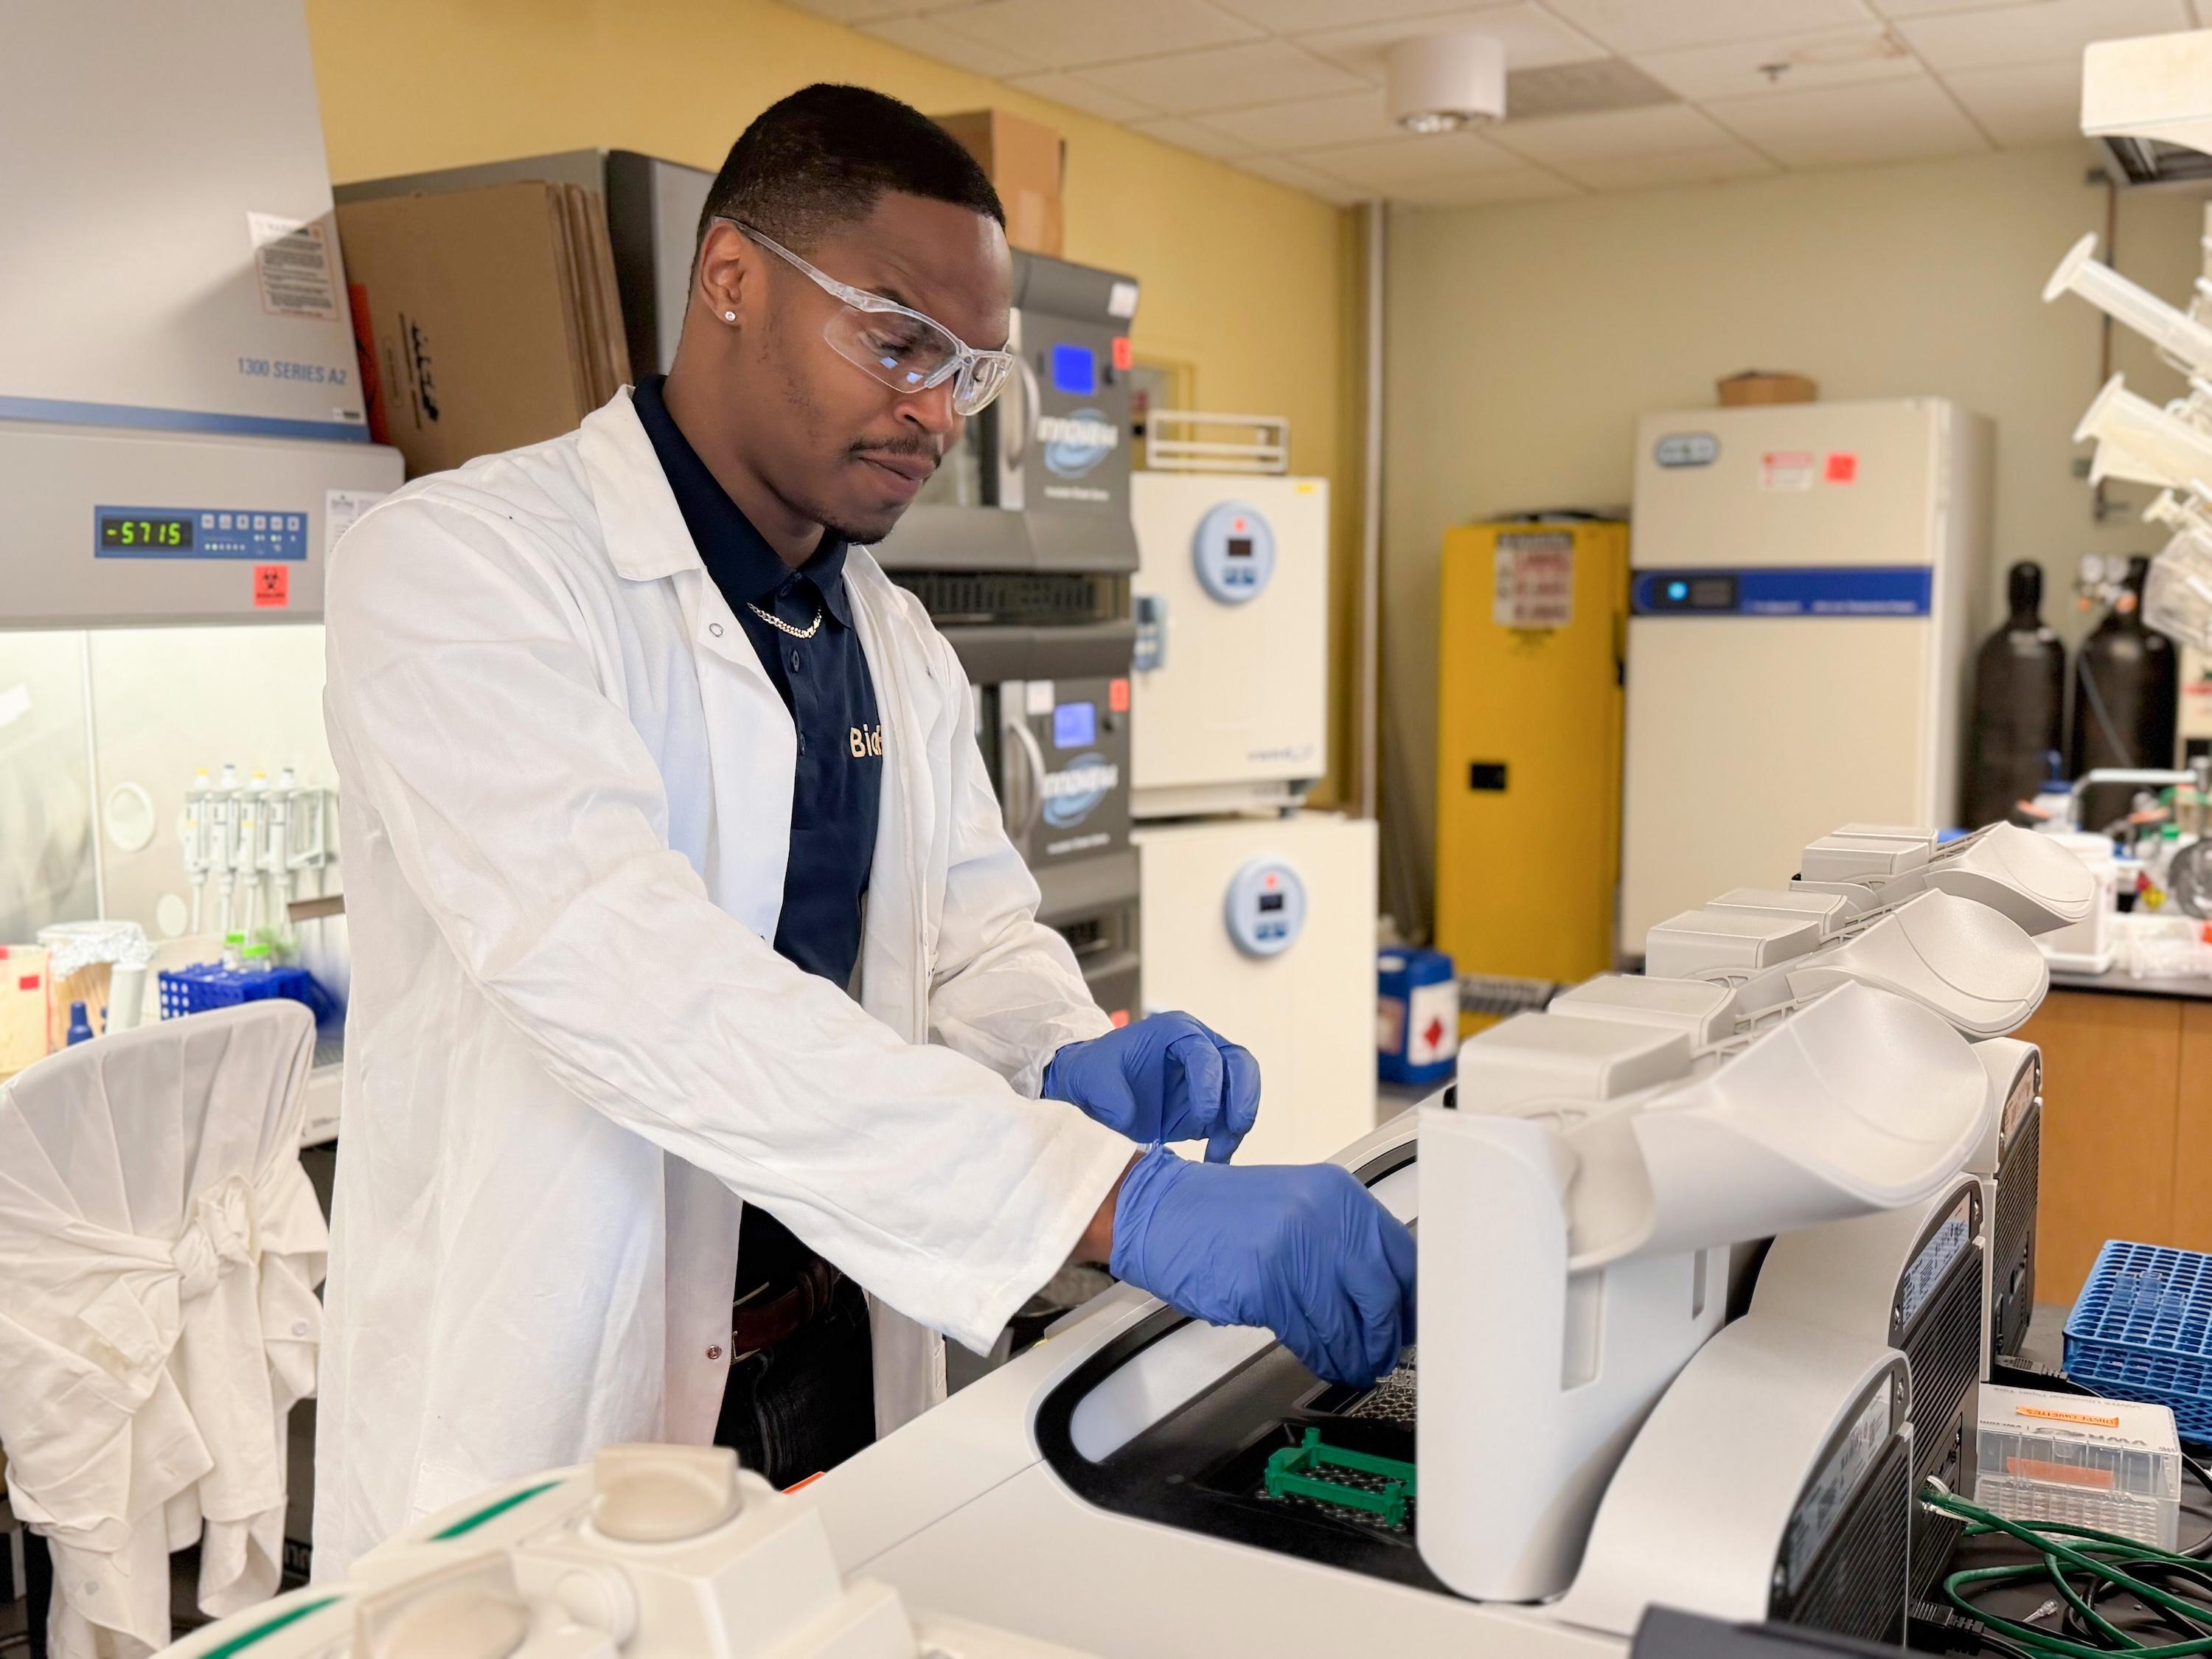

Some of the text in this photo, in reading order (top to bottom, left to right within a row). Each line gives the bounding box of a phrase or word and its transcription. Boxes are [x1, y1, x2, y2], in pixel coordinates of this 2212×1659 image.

[238, 356, 347, 386] 1300 SERIES A2
